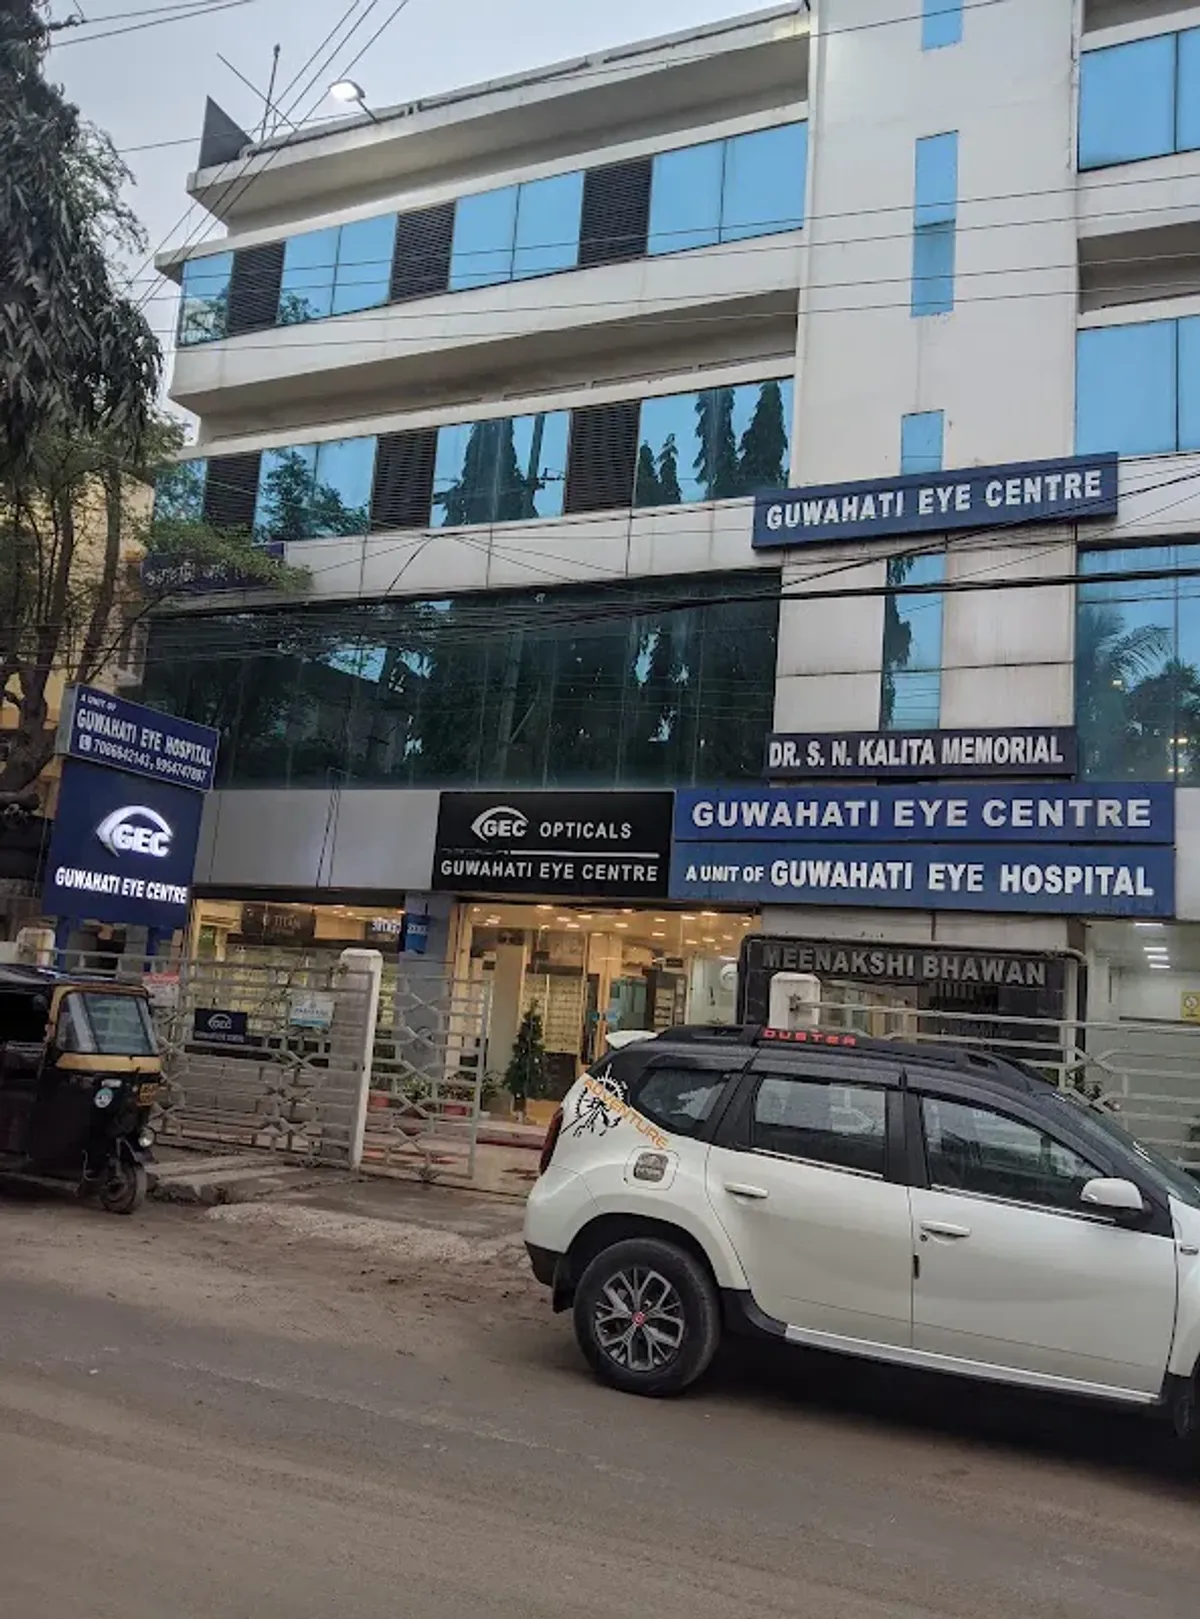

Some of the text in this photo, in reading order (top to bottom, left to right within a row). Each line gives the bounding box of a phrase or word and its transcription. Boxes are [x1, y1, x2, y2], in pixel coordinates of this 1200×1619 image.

[766, 469, 1102, 530] GUWAHATI EYE CENTRE
[77, 708, 211, 766] GUWAHATI EYE HOSPITAL
[769, 736, 1063, 768] DR. S. N. KALITA MEMORIAL
[483, 820, 632, 839] GEC OPTICALS
[692, 799, 1151, 827] GUWAHATI EYE CENTRE
[112, 824, 172, 857] GEC
[55, 867, 187, 904] GUWAHATI EYE CENTRE
[441, 860, 659, 882] GUWAHATI EYE CENTRE
[686, 861, 1153, 896] A UNIT OF GUWAHATI EYE HOSPITAL
[762, 945, 1046, 985] MEENAKSHI BHAWAN
[764, 1028, 857, 1046] DUSTER
[584, 1079, 669, 1149] ADVENTURE
